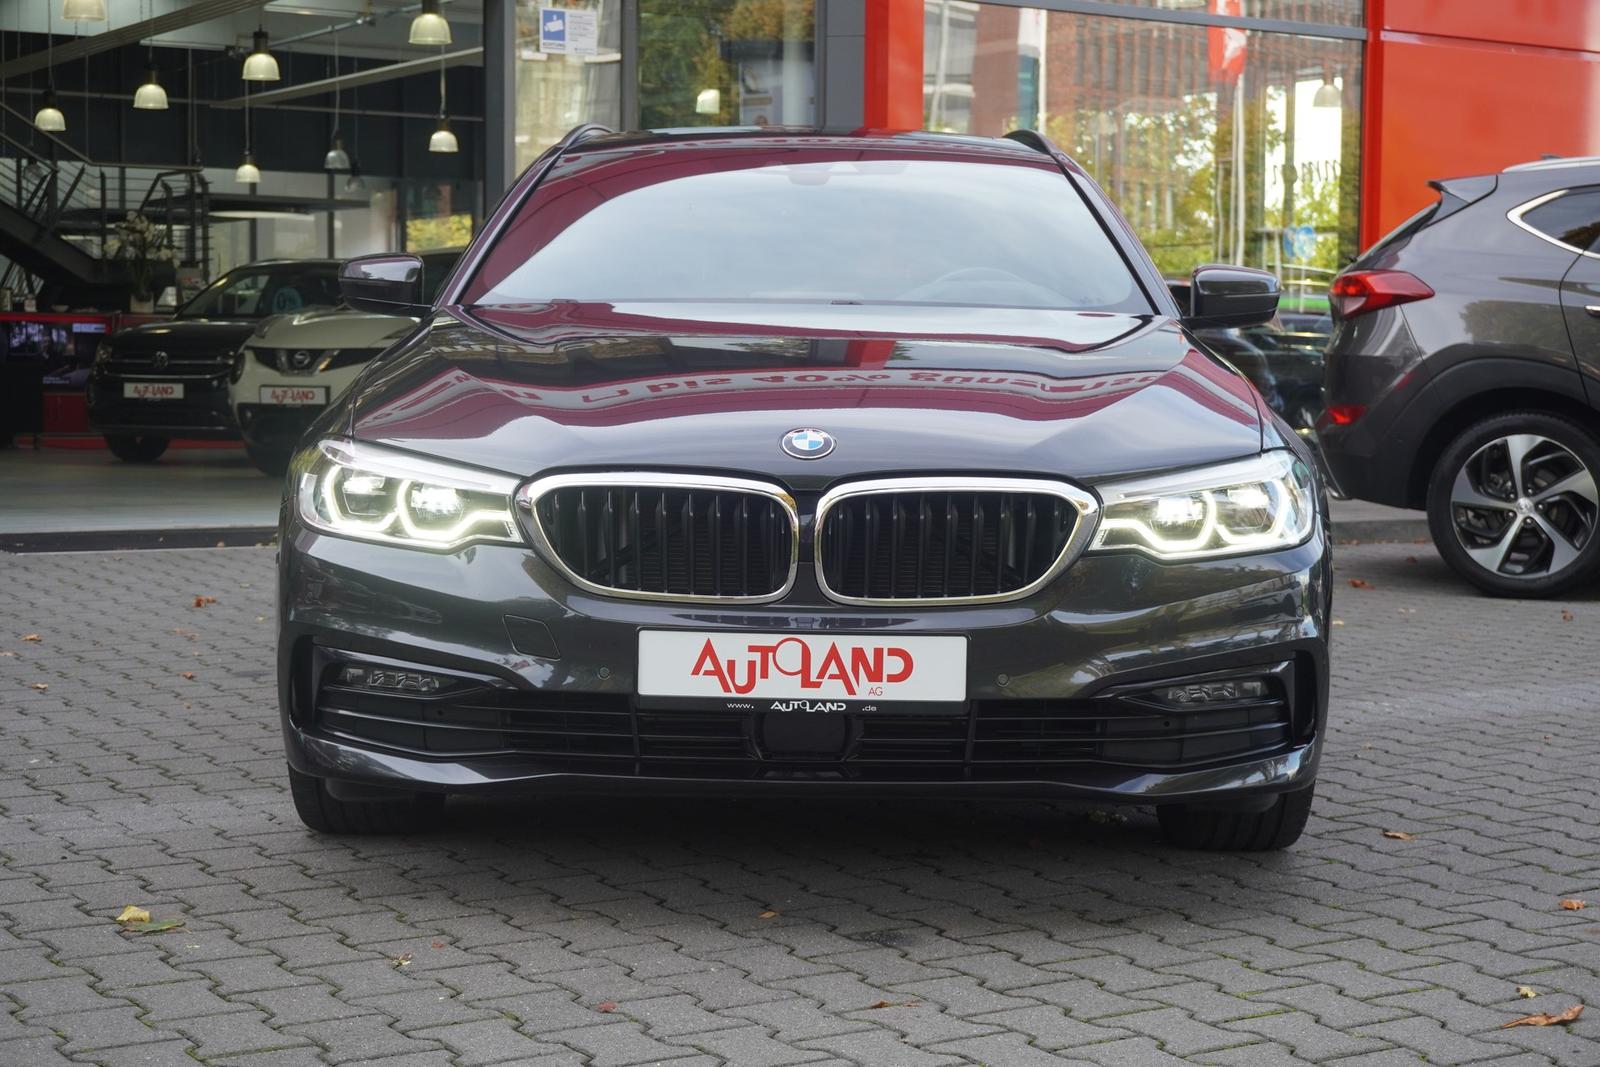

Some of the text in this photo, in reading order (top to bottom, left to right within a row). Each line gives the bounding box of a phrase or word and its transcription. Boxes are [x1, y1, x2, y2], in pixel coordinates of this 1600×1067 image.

[690, 636, 914, 697] AUTOLAND
[868, 686, 884, 697] AG
[726, 699, 877, 713] www. AUTOLAND .de
